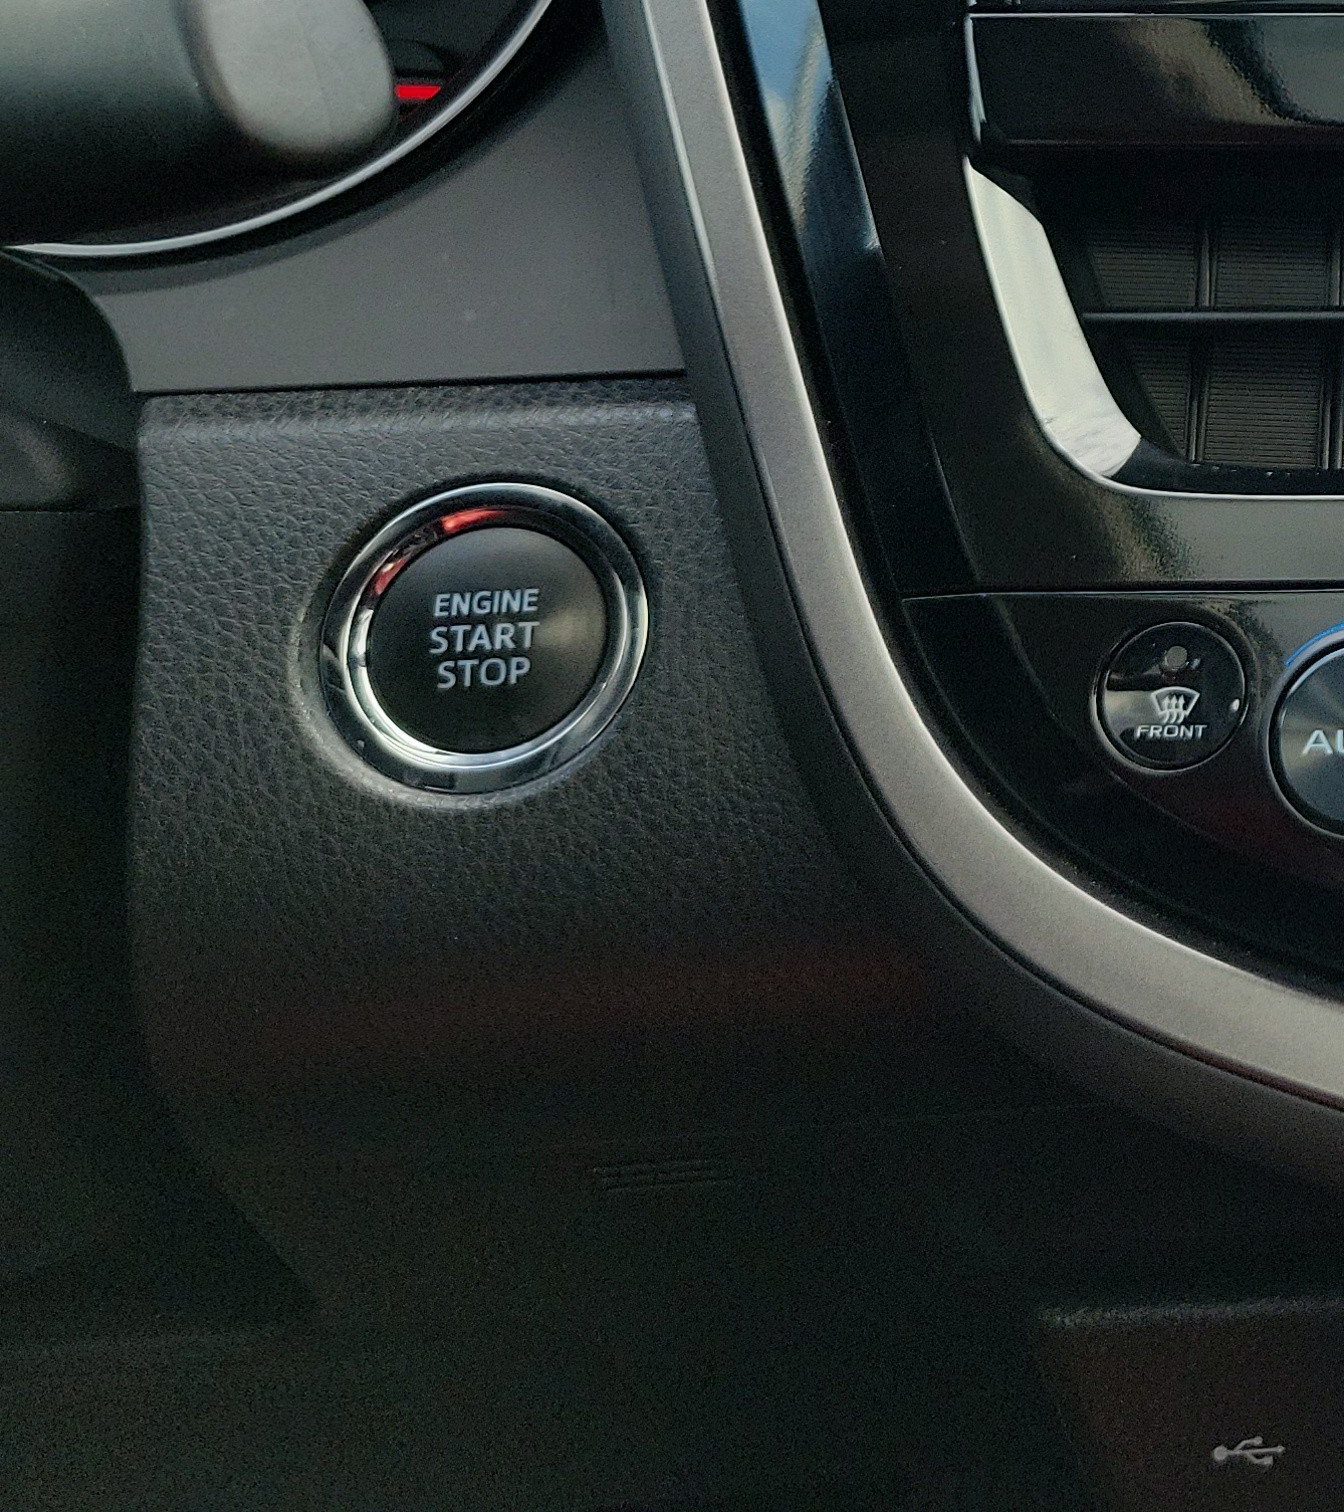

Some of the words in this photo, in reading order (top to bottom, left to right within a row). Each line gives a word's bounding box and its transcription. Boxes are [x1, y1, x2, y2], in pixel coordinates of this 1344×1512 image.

[432, 588, 541, 618] ENGINE
[428, 621, 541, 655] START
[436, 656, 532, 691] STOP
[1132, 722, 1209, 741] FRONT
